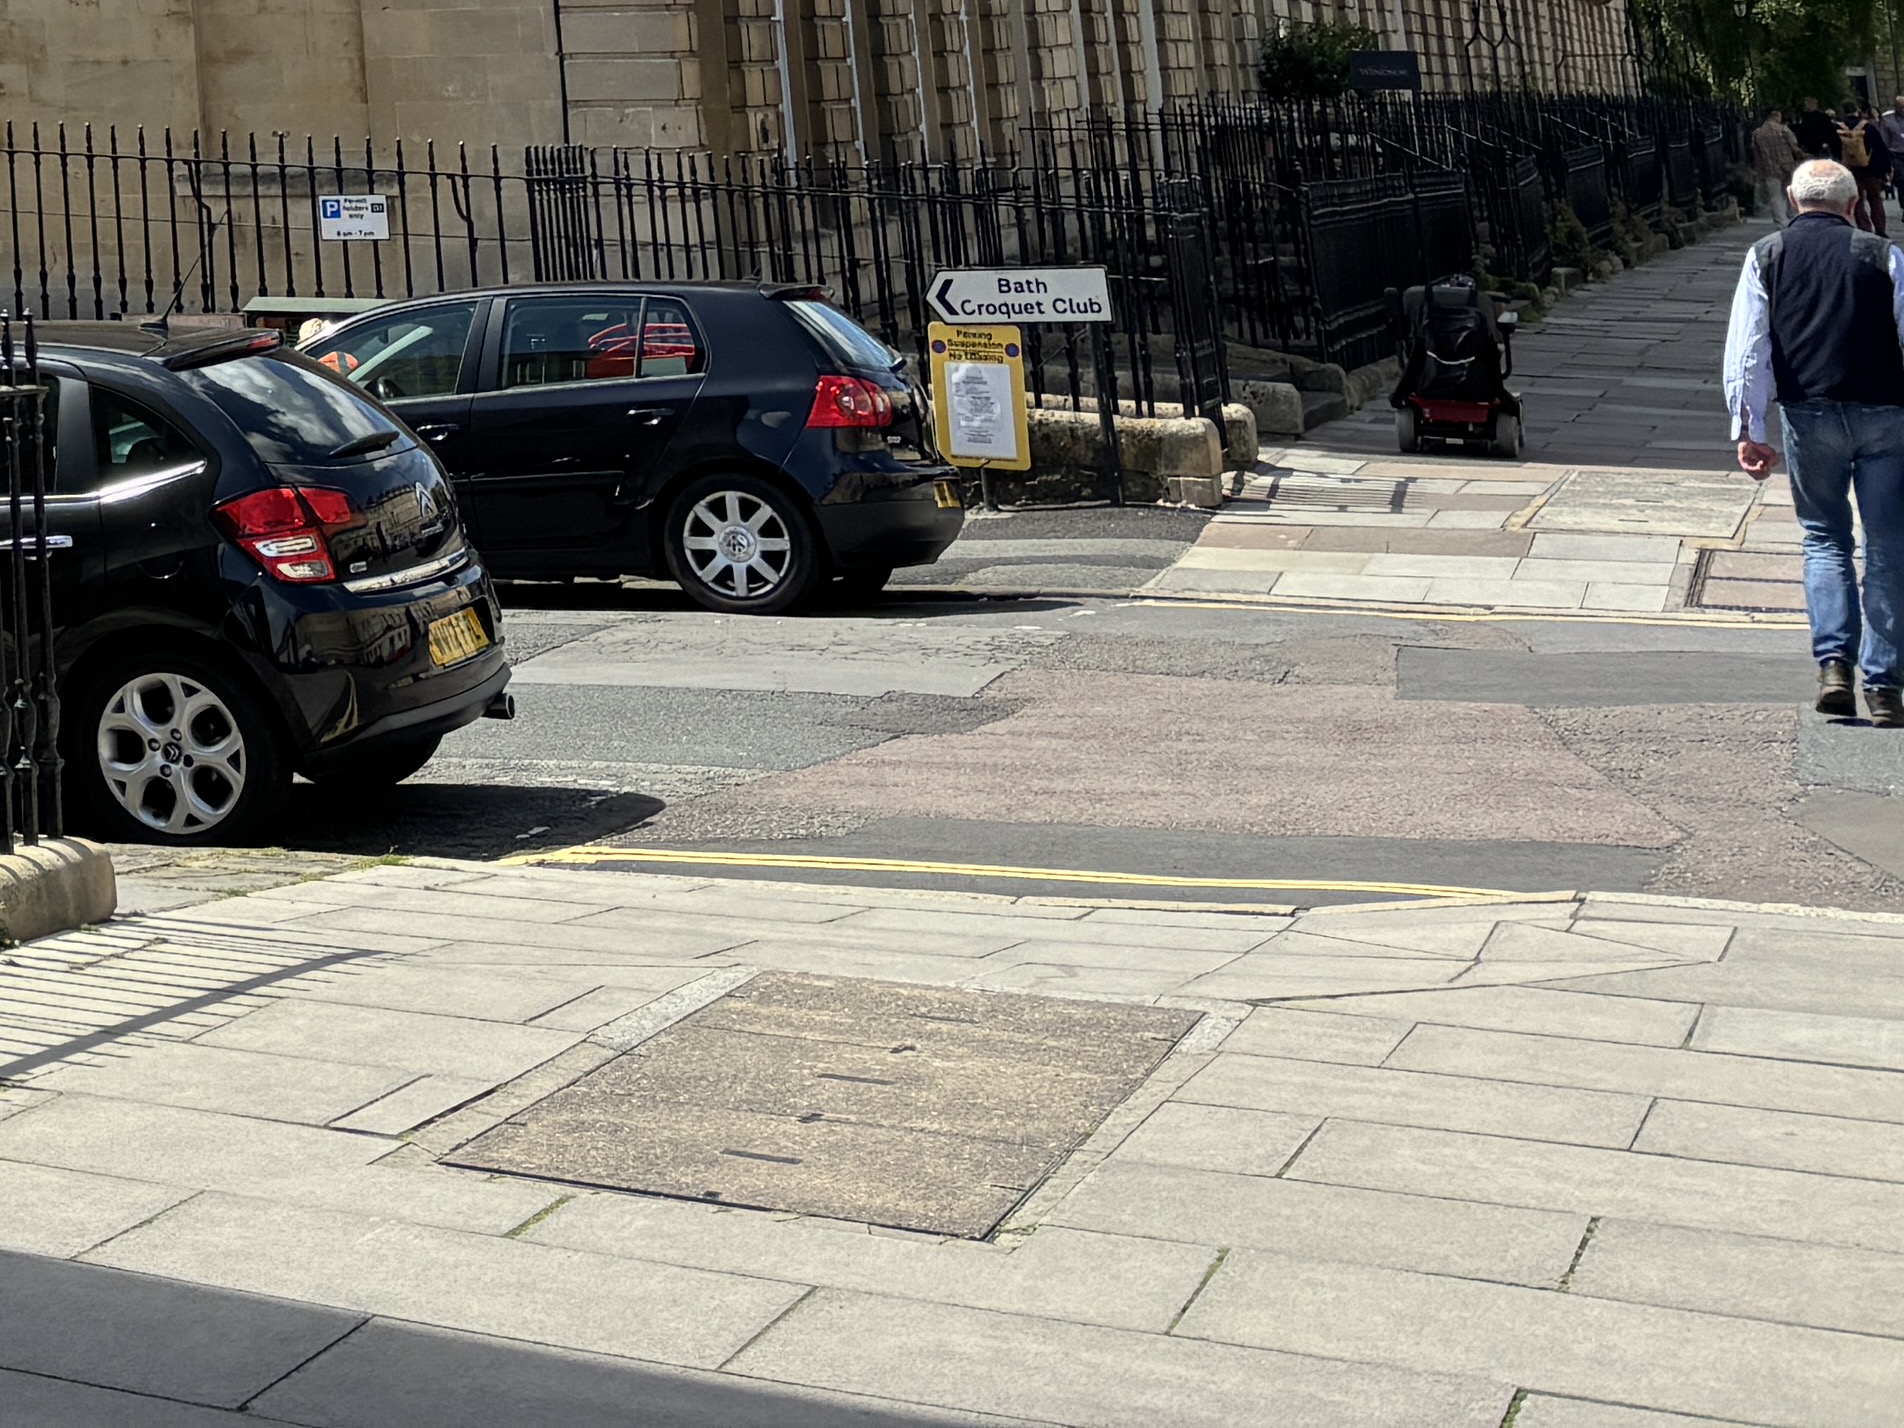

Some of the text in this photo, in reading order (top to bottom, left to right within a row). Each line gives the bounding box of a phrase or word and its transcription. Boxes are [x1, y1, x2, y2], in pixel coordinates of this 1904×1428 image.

[326, 202, 338, 217] P
[997, 278, 1048, 294] Bath
[960, 297, 1102, 319] Croquet Club
